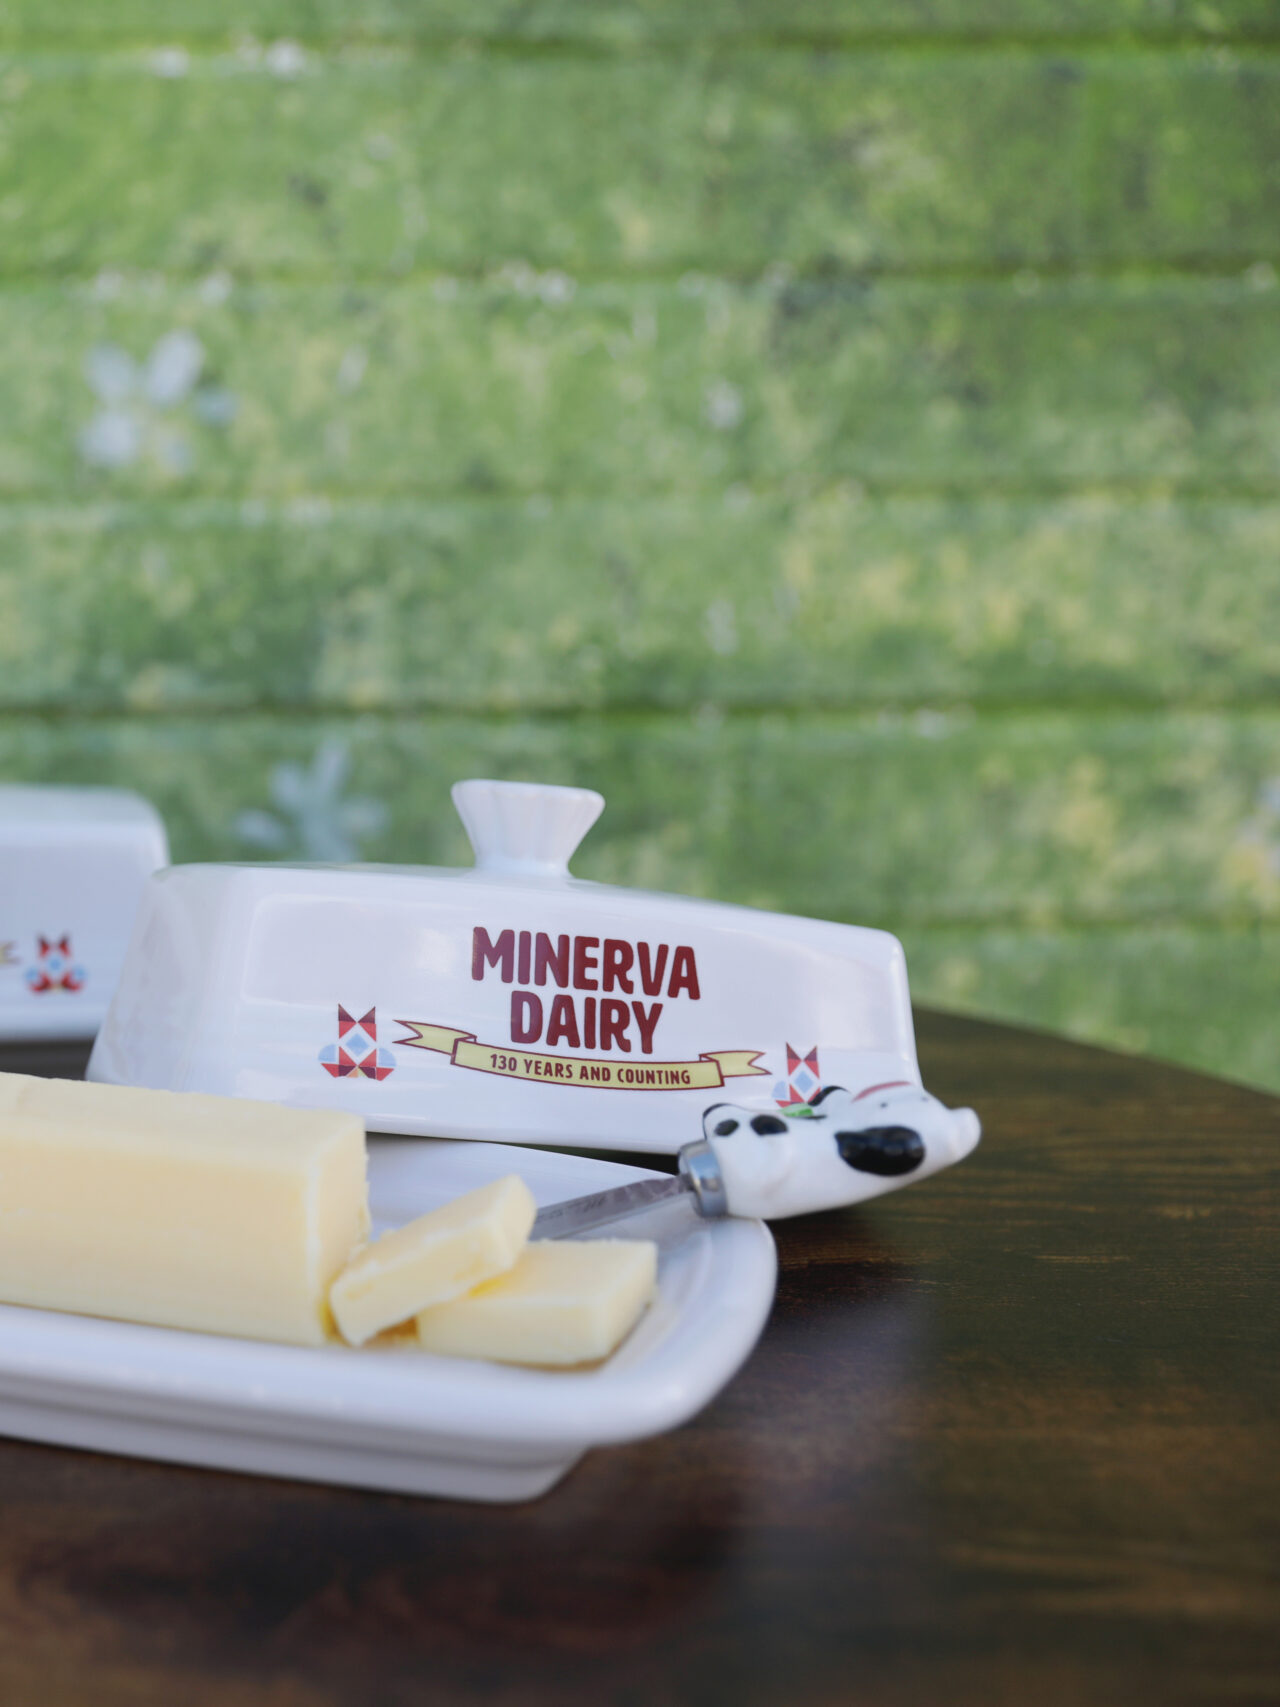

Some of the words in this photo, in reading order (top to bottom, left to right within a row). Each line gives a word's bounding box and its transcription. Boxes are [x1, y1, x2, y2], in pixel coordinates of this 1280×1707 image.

[471, 926, 701, 1000] MINERVA
[510, 990, 663, 1054] DAIRY
[490, 1053, 517, 1072] 130
[523, 1058, 573, 1079] YEARS
[579, 1065, 611, 1082] AND
[617, 1068, 691, 1085] COUNTING
